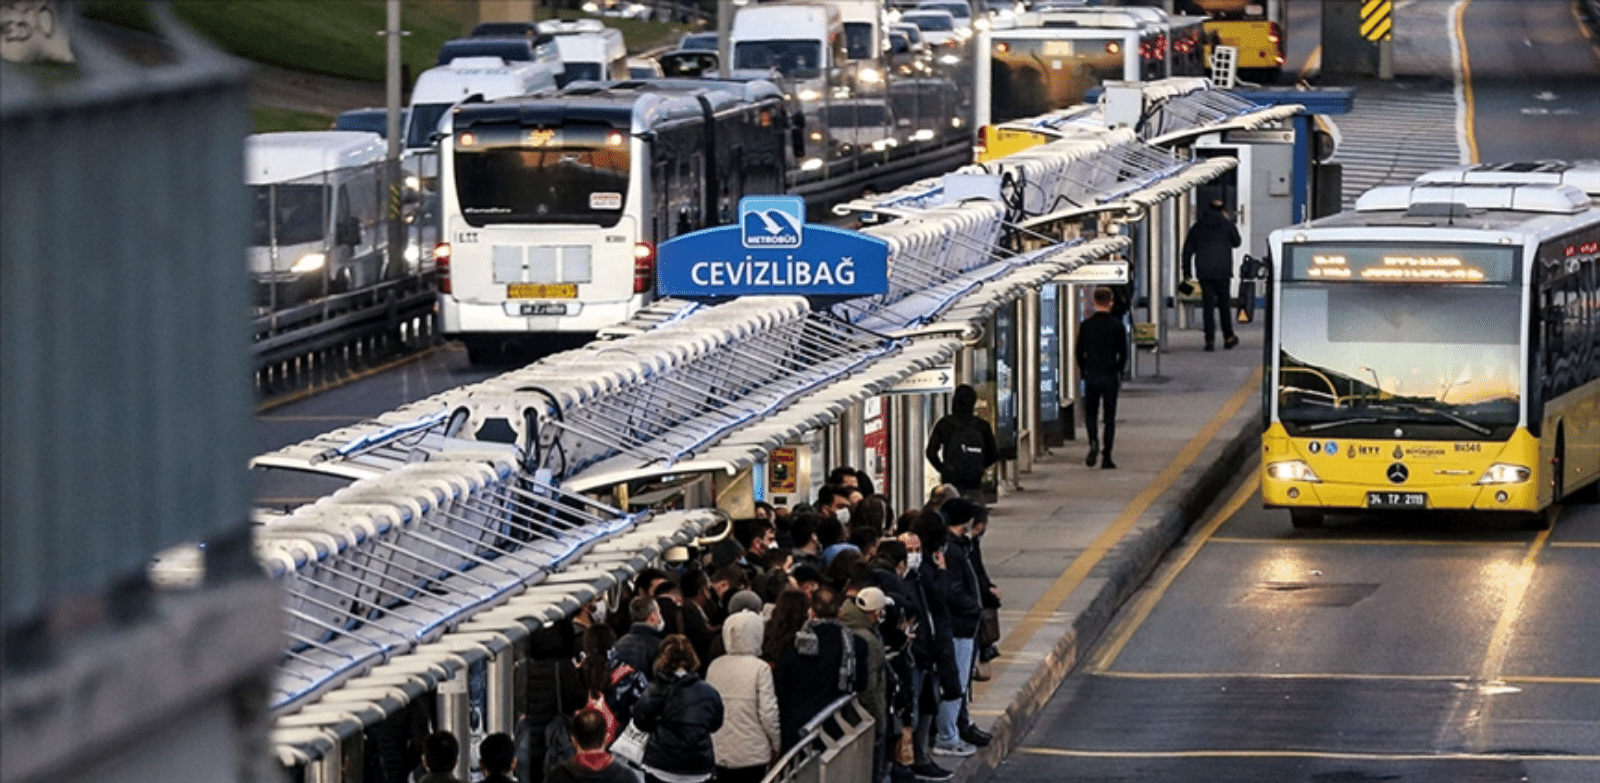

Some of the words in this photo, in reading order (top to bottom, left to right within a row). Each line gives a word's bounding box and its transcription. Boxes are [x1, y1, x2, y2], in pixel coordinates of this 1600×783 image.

[747, 234, 796, 244] METROBÜS
[691, 255, 855, 285] CEVİZLİBAĞ
[1370, 494, 1382, 504] 34
